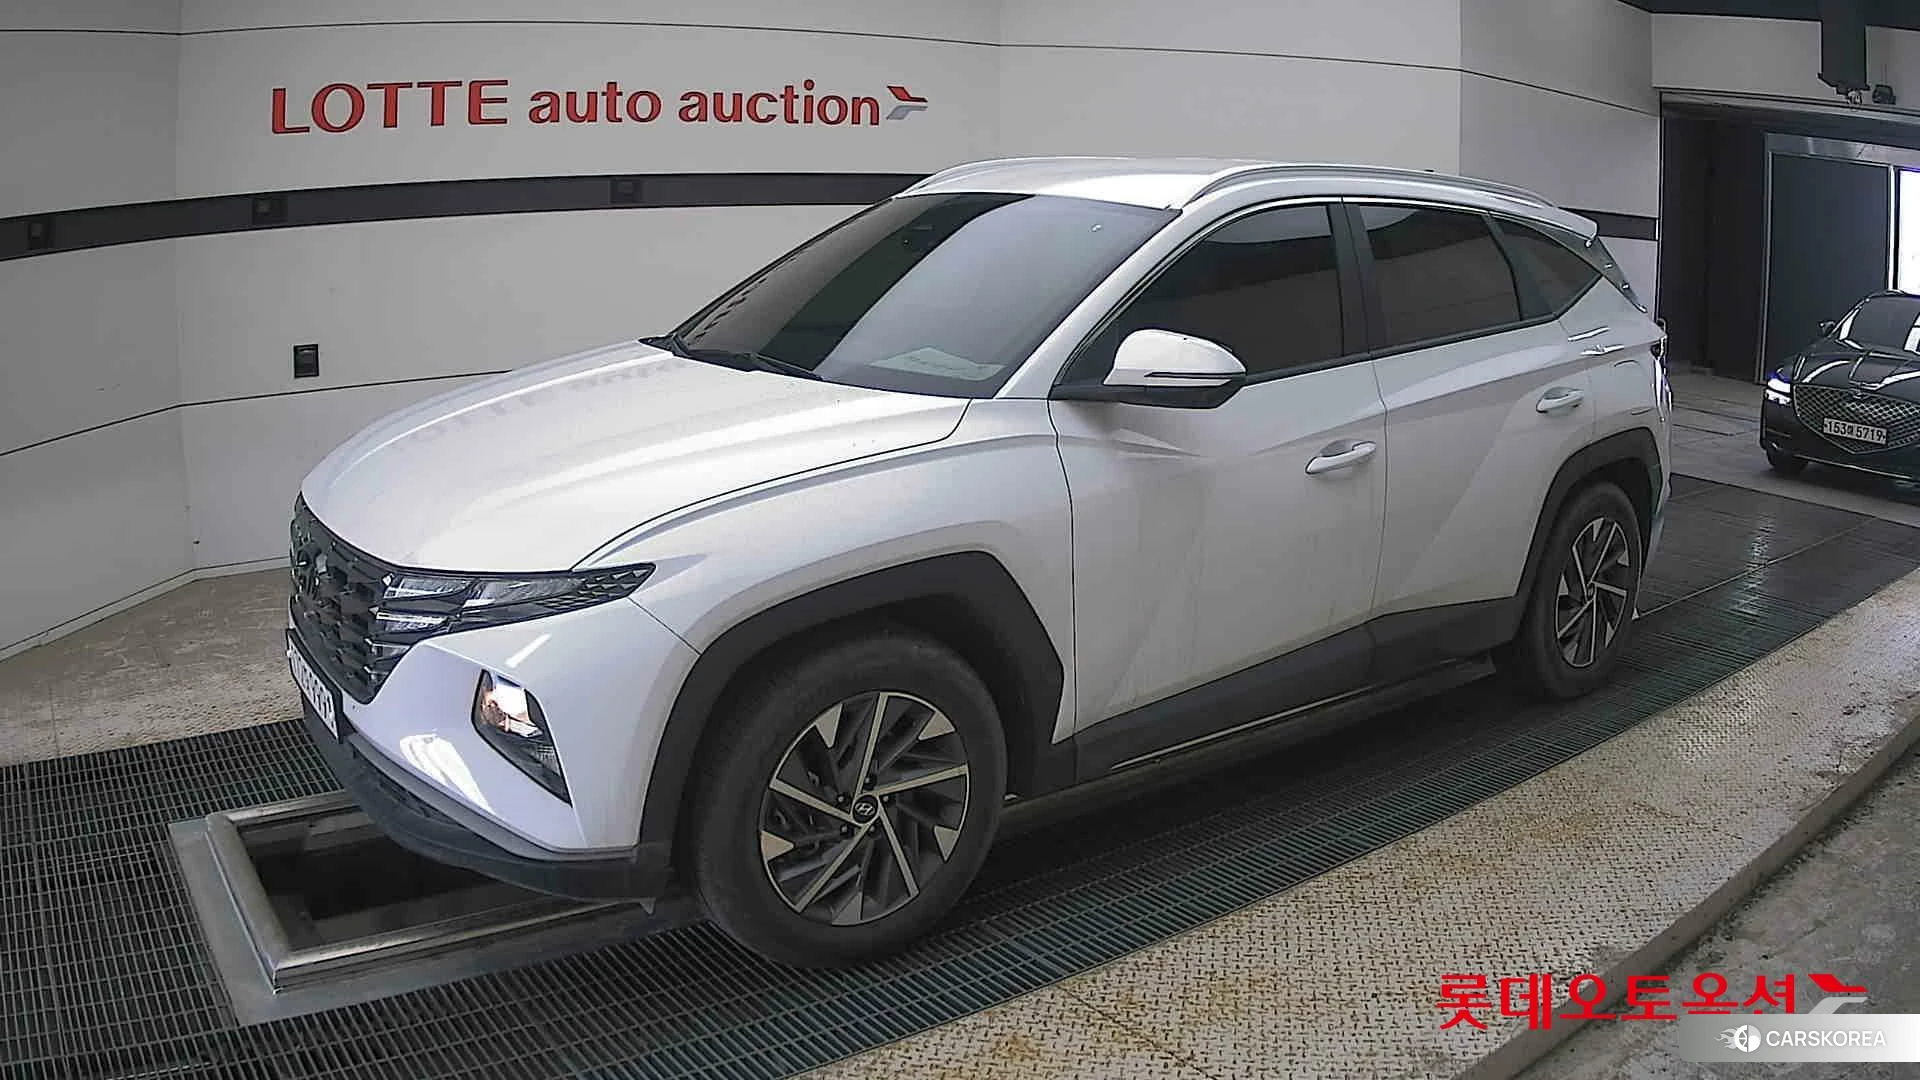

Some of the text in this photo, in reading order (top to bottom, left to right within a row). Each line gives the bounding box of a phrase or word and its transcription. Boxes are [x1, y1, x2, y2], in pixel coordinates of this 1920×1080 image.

[272, 79, 880, 134] LOTTE auto auction
